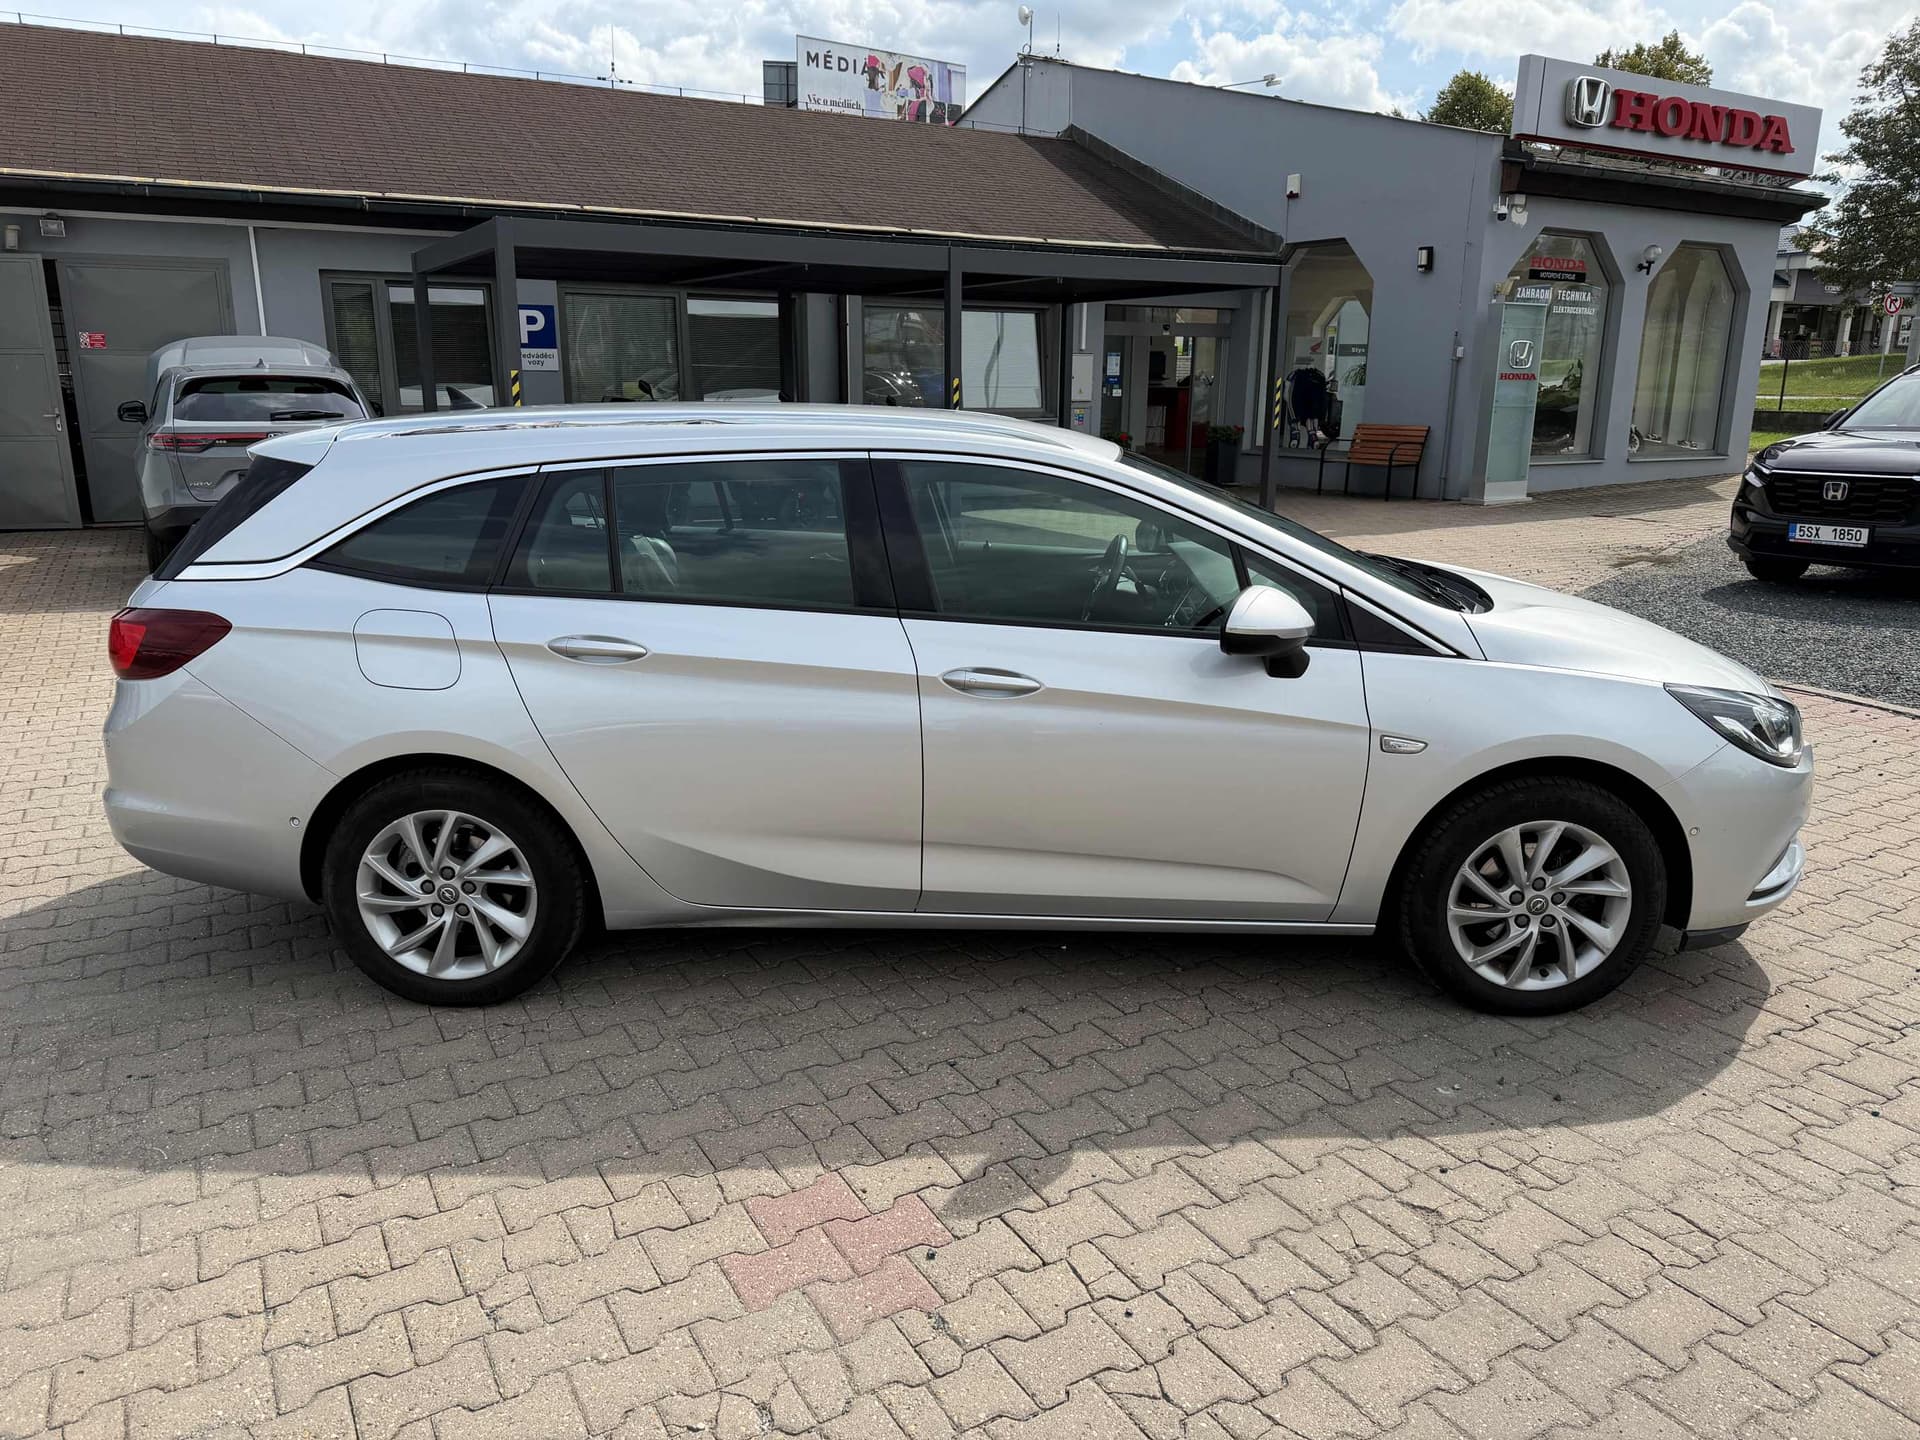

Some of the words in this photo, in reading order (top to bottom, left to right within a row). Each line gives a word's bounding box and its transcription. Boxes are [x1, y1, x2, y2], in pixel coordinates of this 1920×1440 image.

[1613, 89, 1795, 153] HONDA
[1530, 257, 1587, 271] HONDA
[1558, 290, 1591, 301] TECHNIKA
[518, 309, 545, 343] P
[520, 351, 555, 359] edváděcí
[527, 359, 545, 367] vozy
[1799, 526, 1821, 538] 5SX
[1832, 528, 1862, 541] 1850
